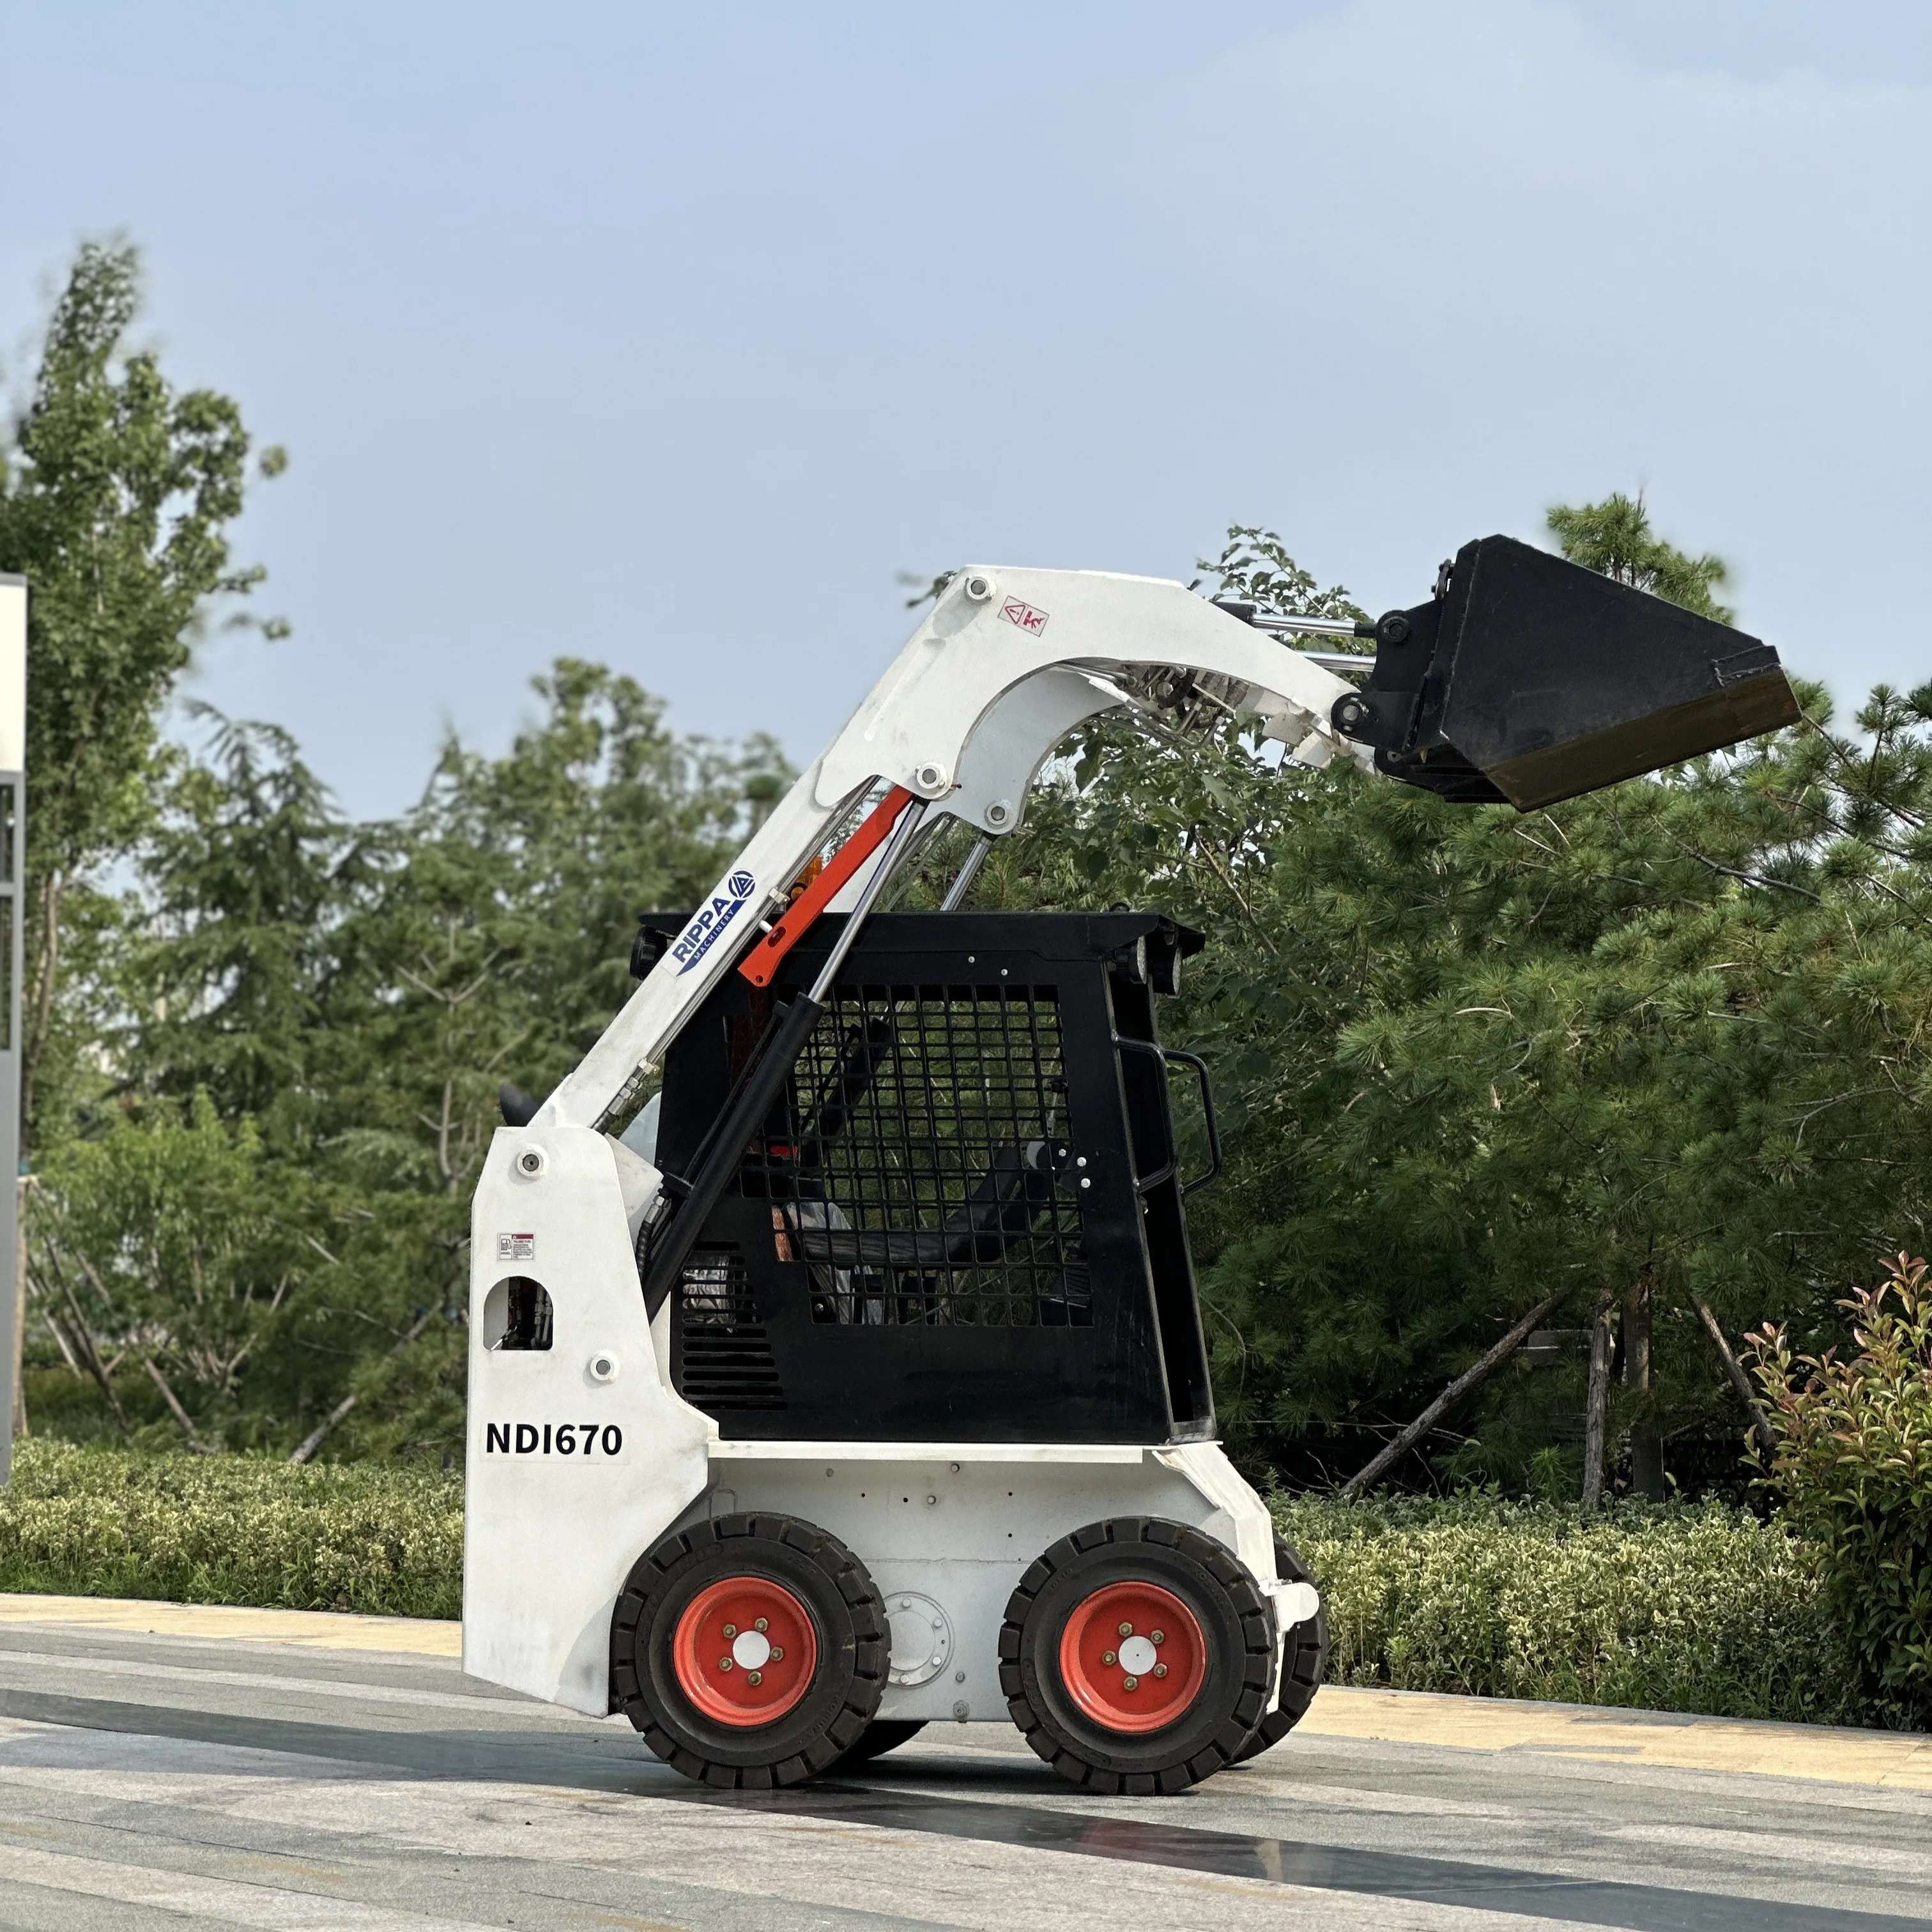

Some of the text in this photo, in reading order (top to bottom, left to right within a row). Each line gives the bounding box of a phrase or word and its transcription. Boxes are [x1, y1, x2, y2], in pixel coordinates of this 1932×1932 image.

[672, 898, 731, 963] RIPPA
[694, 909, 735, 960] MACHINERY
[486, 1423, 622, 1455] NDI670
